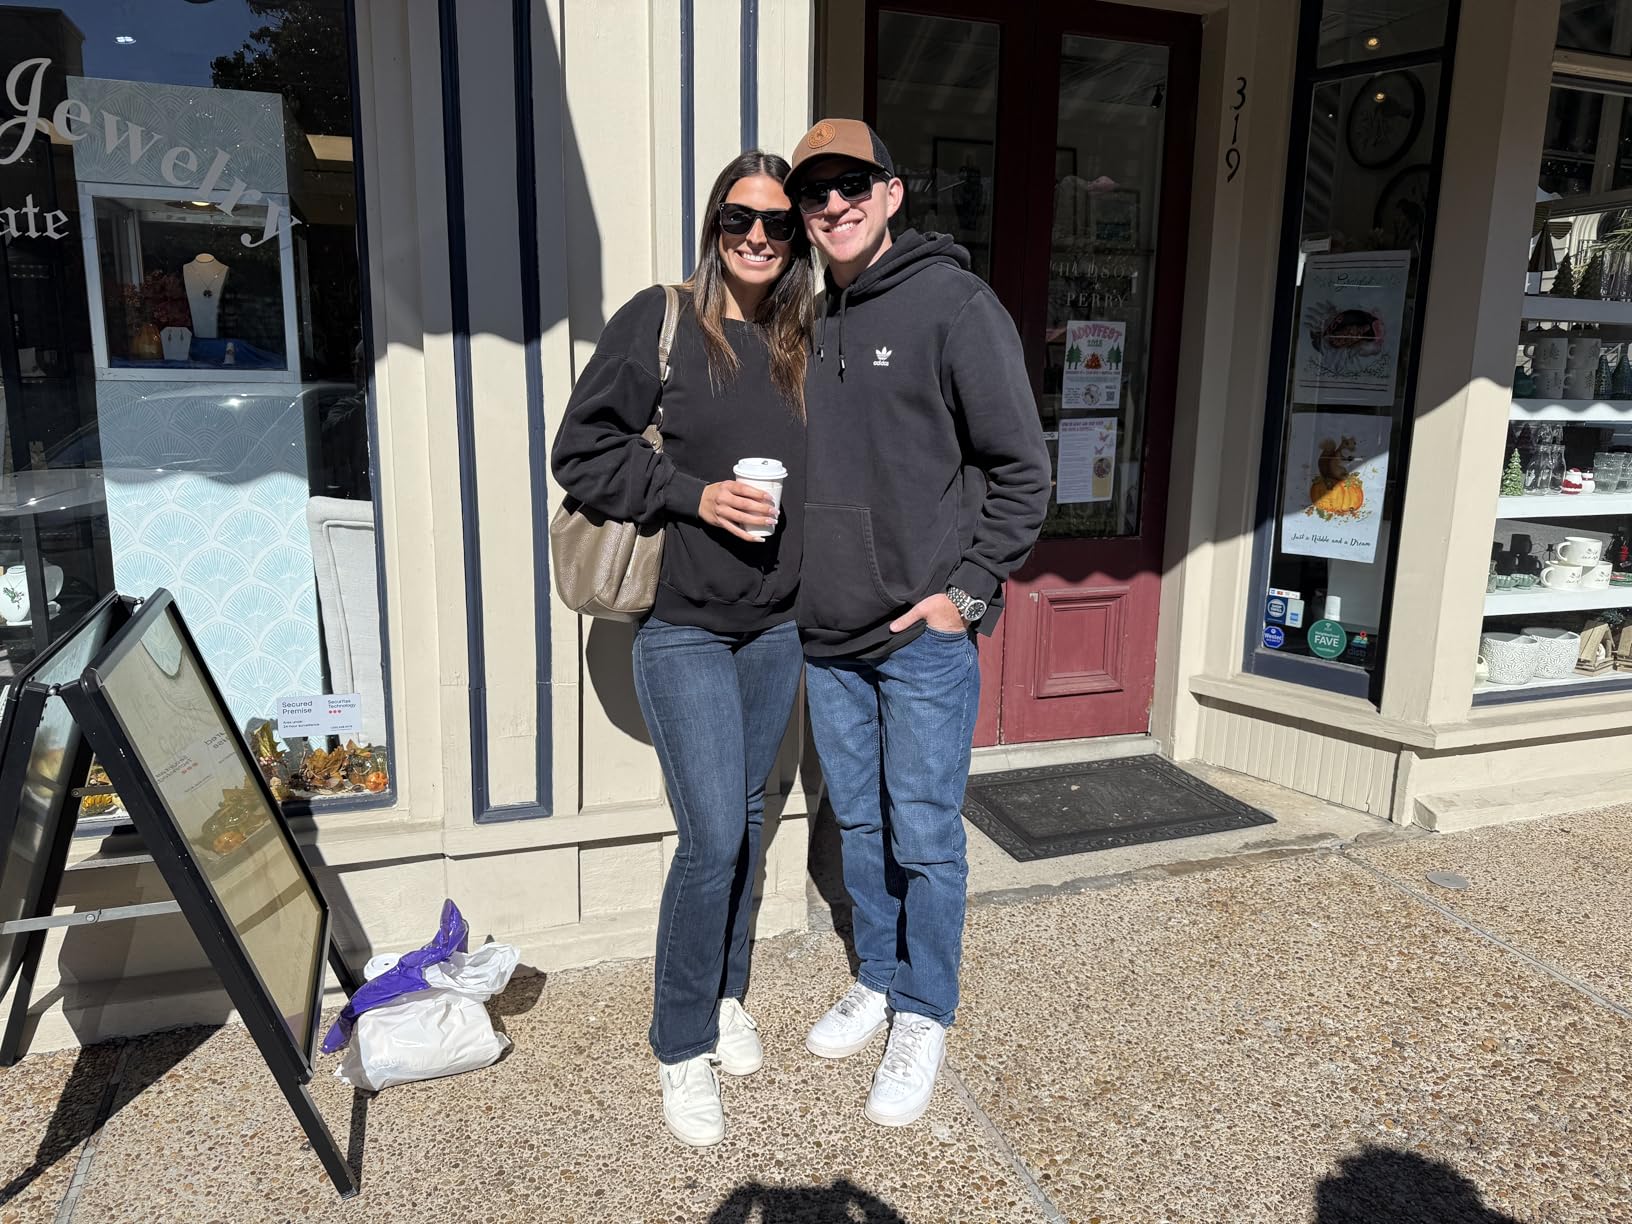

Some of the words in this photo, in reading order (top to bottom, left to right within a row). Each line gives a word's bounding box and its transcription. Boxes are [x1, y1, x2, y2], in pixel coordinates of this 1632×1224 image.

[1229, 76, 1247, 183] 319
[0, 58, 302, 248] Jewelry
[1065, 290, 1128, 308] PERRY
[1291, 533, 1304, 541] Just
[1311, 534, 1330, 544] Nibble
[1350, 538, 1371, 547] Dream
[1314, 634, 1340, 648] FAVE
[282, 701, 313, 709] Secured
[282, 708, 313, 716] Premise
